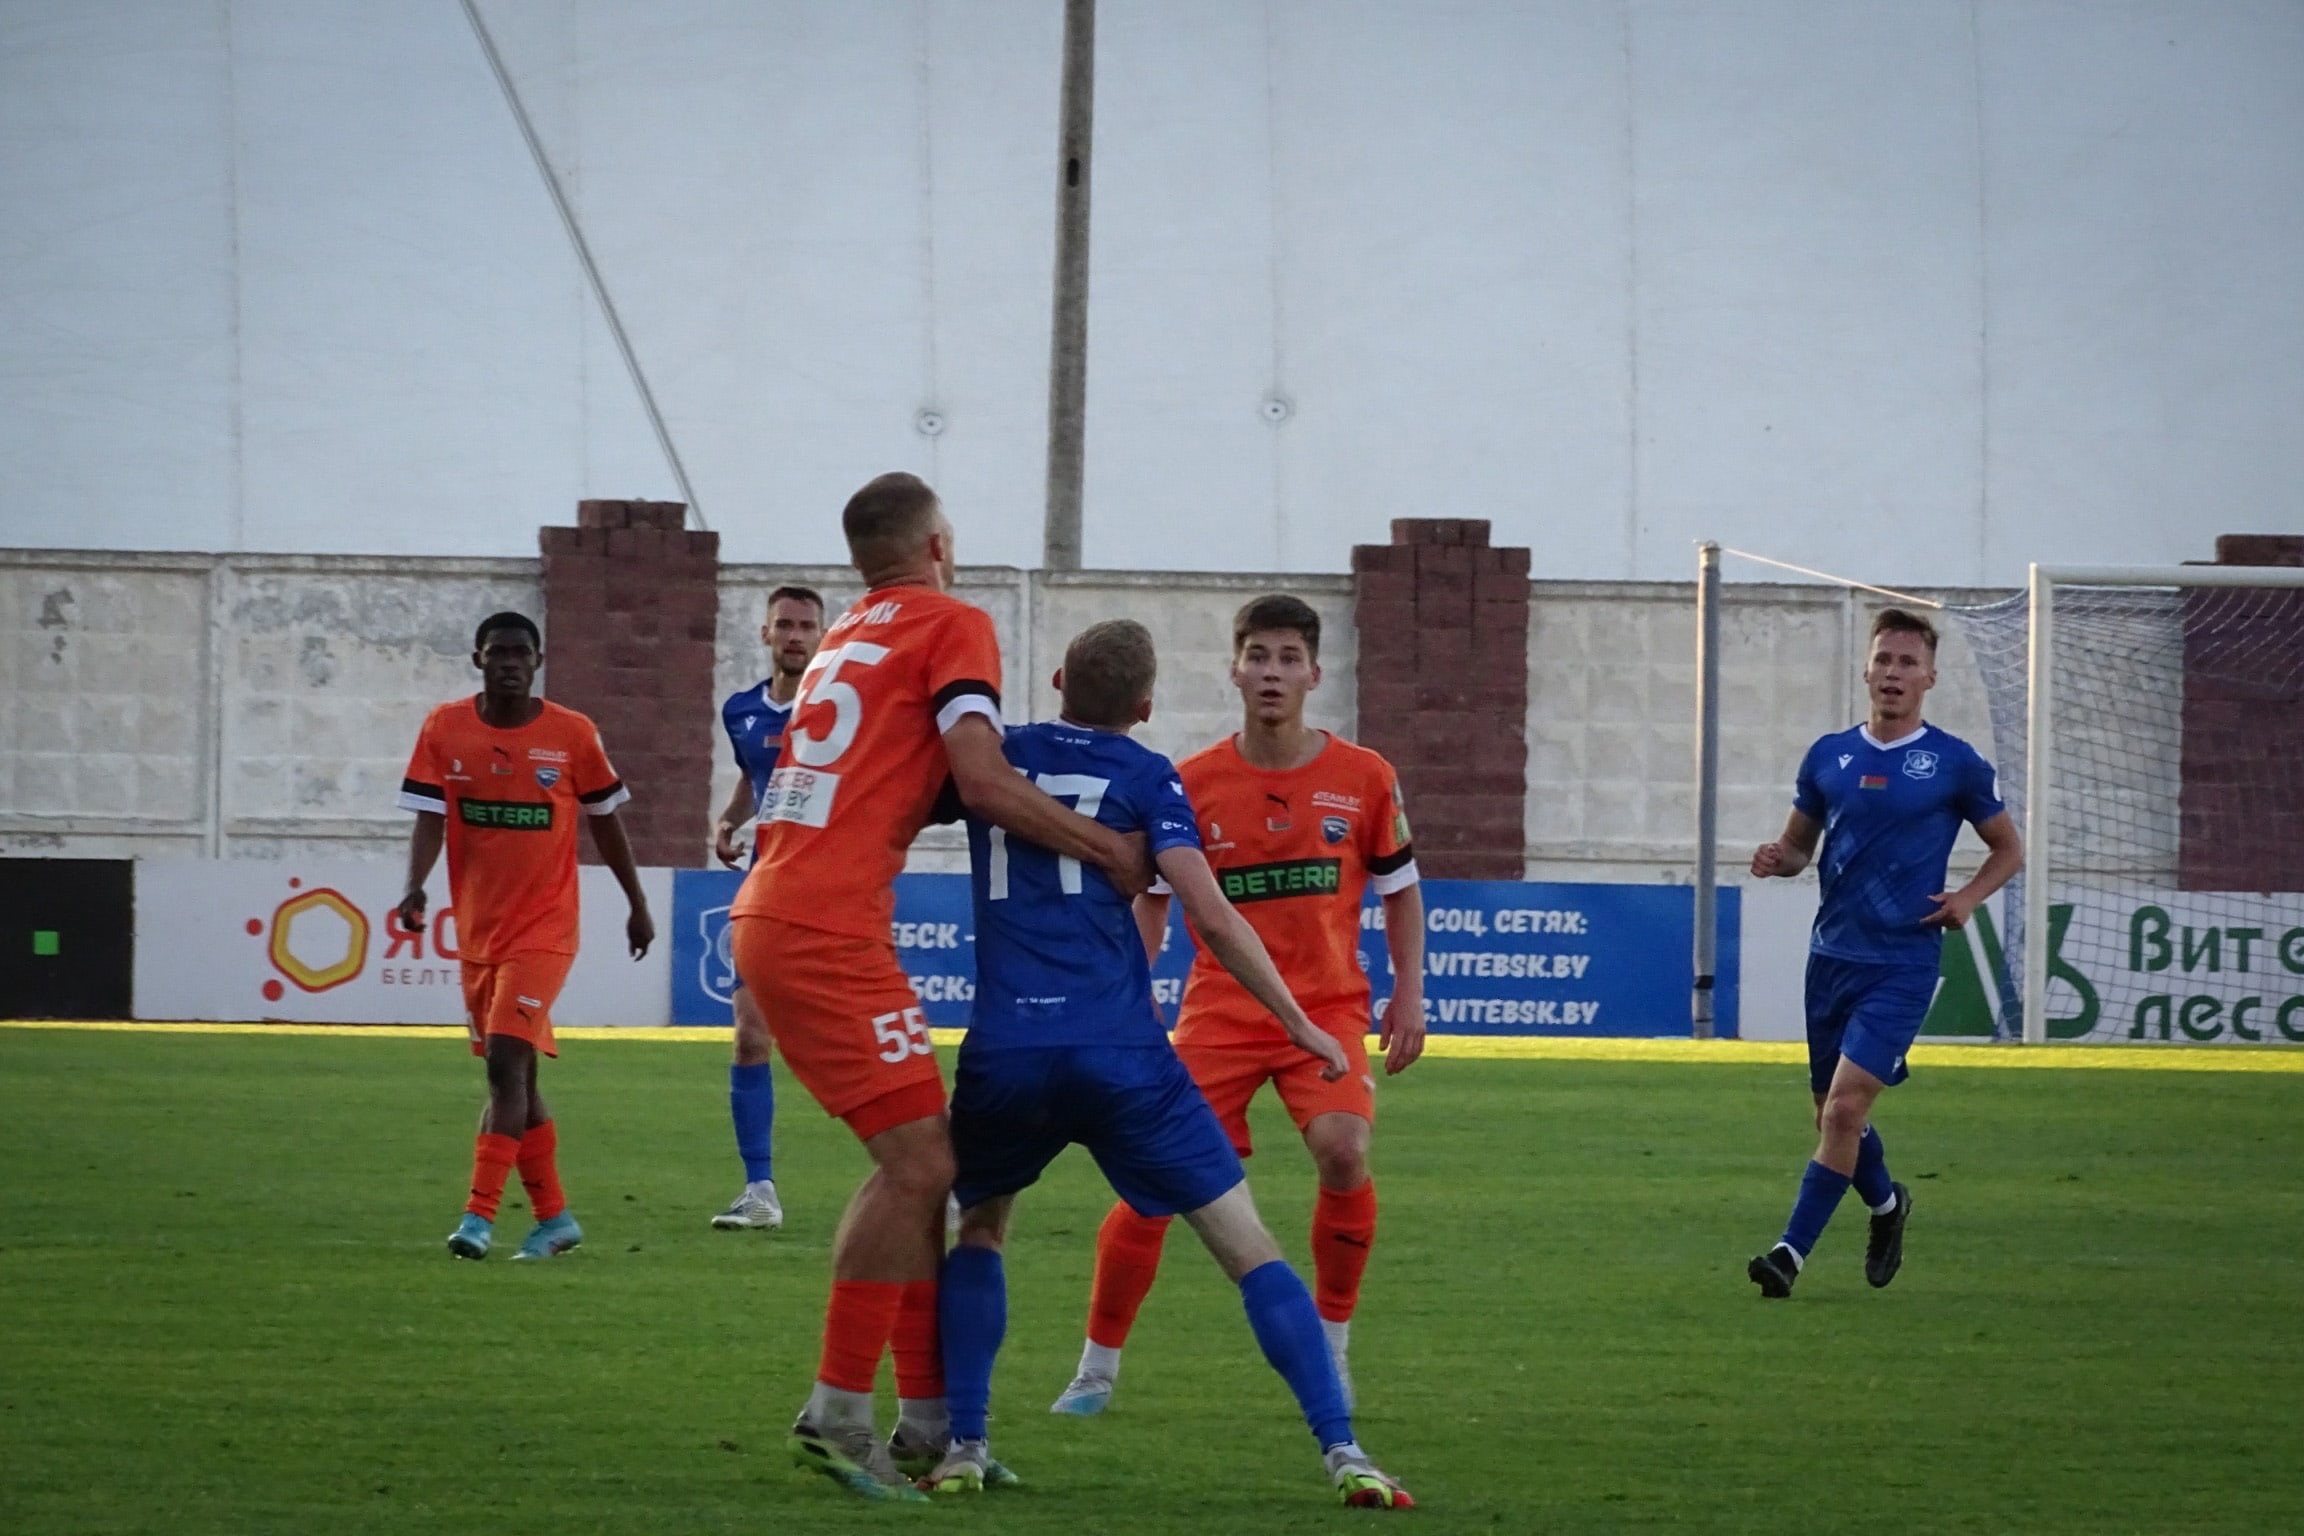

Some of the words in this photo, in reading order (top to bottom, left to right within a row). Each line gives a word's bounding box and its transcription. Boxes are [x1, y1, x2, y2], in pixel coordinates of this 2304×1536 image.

[1494, 909, 1589, 935] СЕТЯХ:
[383, 968, 462, 986] БЕЛТ
[1388, 952, 1590, 979] .VITEBSK.BY
[872, 1006, 932, 1063] 55
